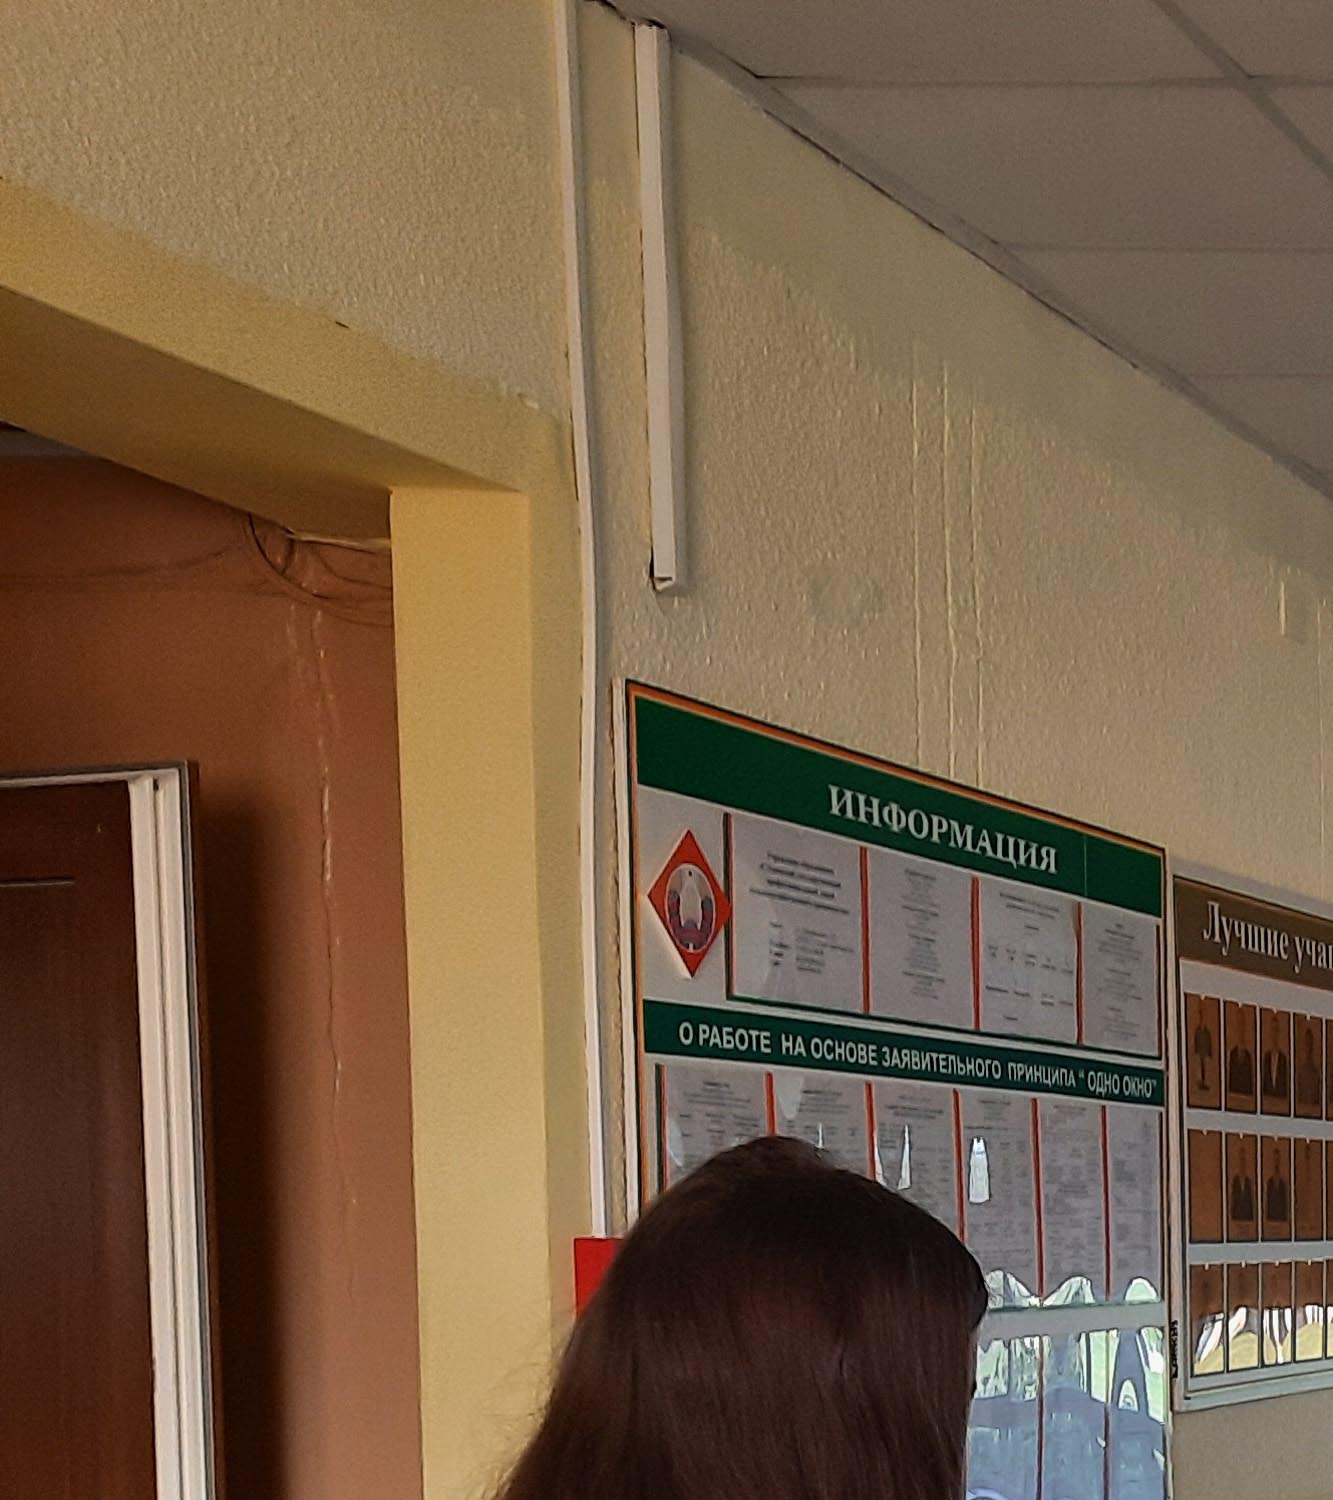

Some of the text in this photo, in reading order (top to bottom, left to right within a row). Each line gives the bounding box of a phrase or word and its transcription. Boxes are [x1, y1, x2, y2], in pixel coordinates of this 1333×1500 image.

[828, 784, 1058, 874] ИНФОРМАЦИЯ
[1203, 901, 1289, 957] Лучшие
[679, 1022, 693, 1045] О
[699, 1024, 772, 1053] РАБОТЕ
[781, 1033, 806, 1057] НА
[811, 1037, 878, 1066] ОСНОВЕ
[881, 1046, 1001, 1080] ЗАЯВИТЕЛЬНОГО
[1007, 1062, 1076, 1088] ПРИНЦИПА
